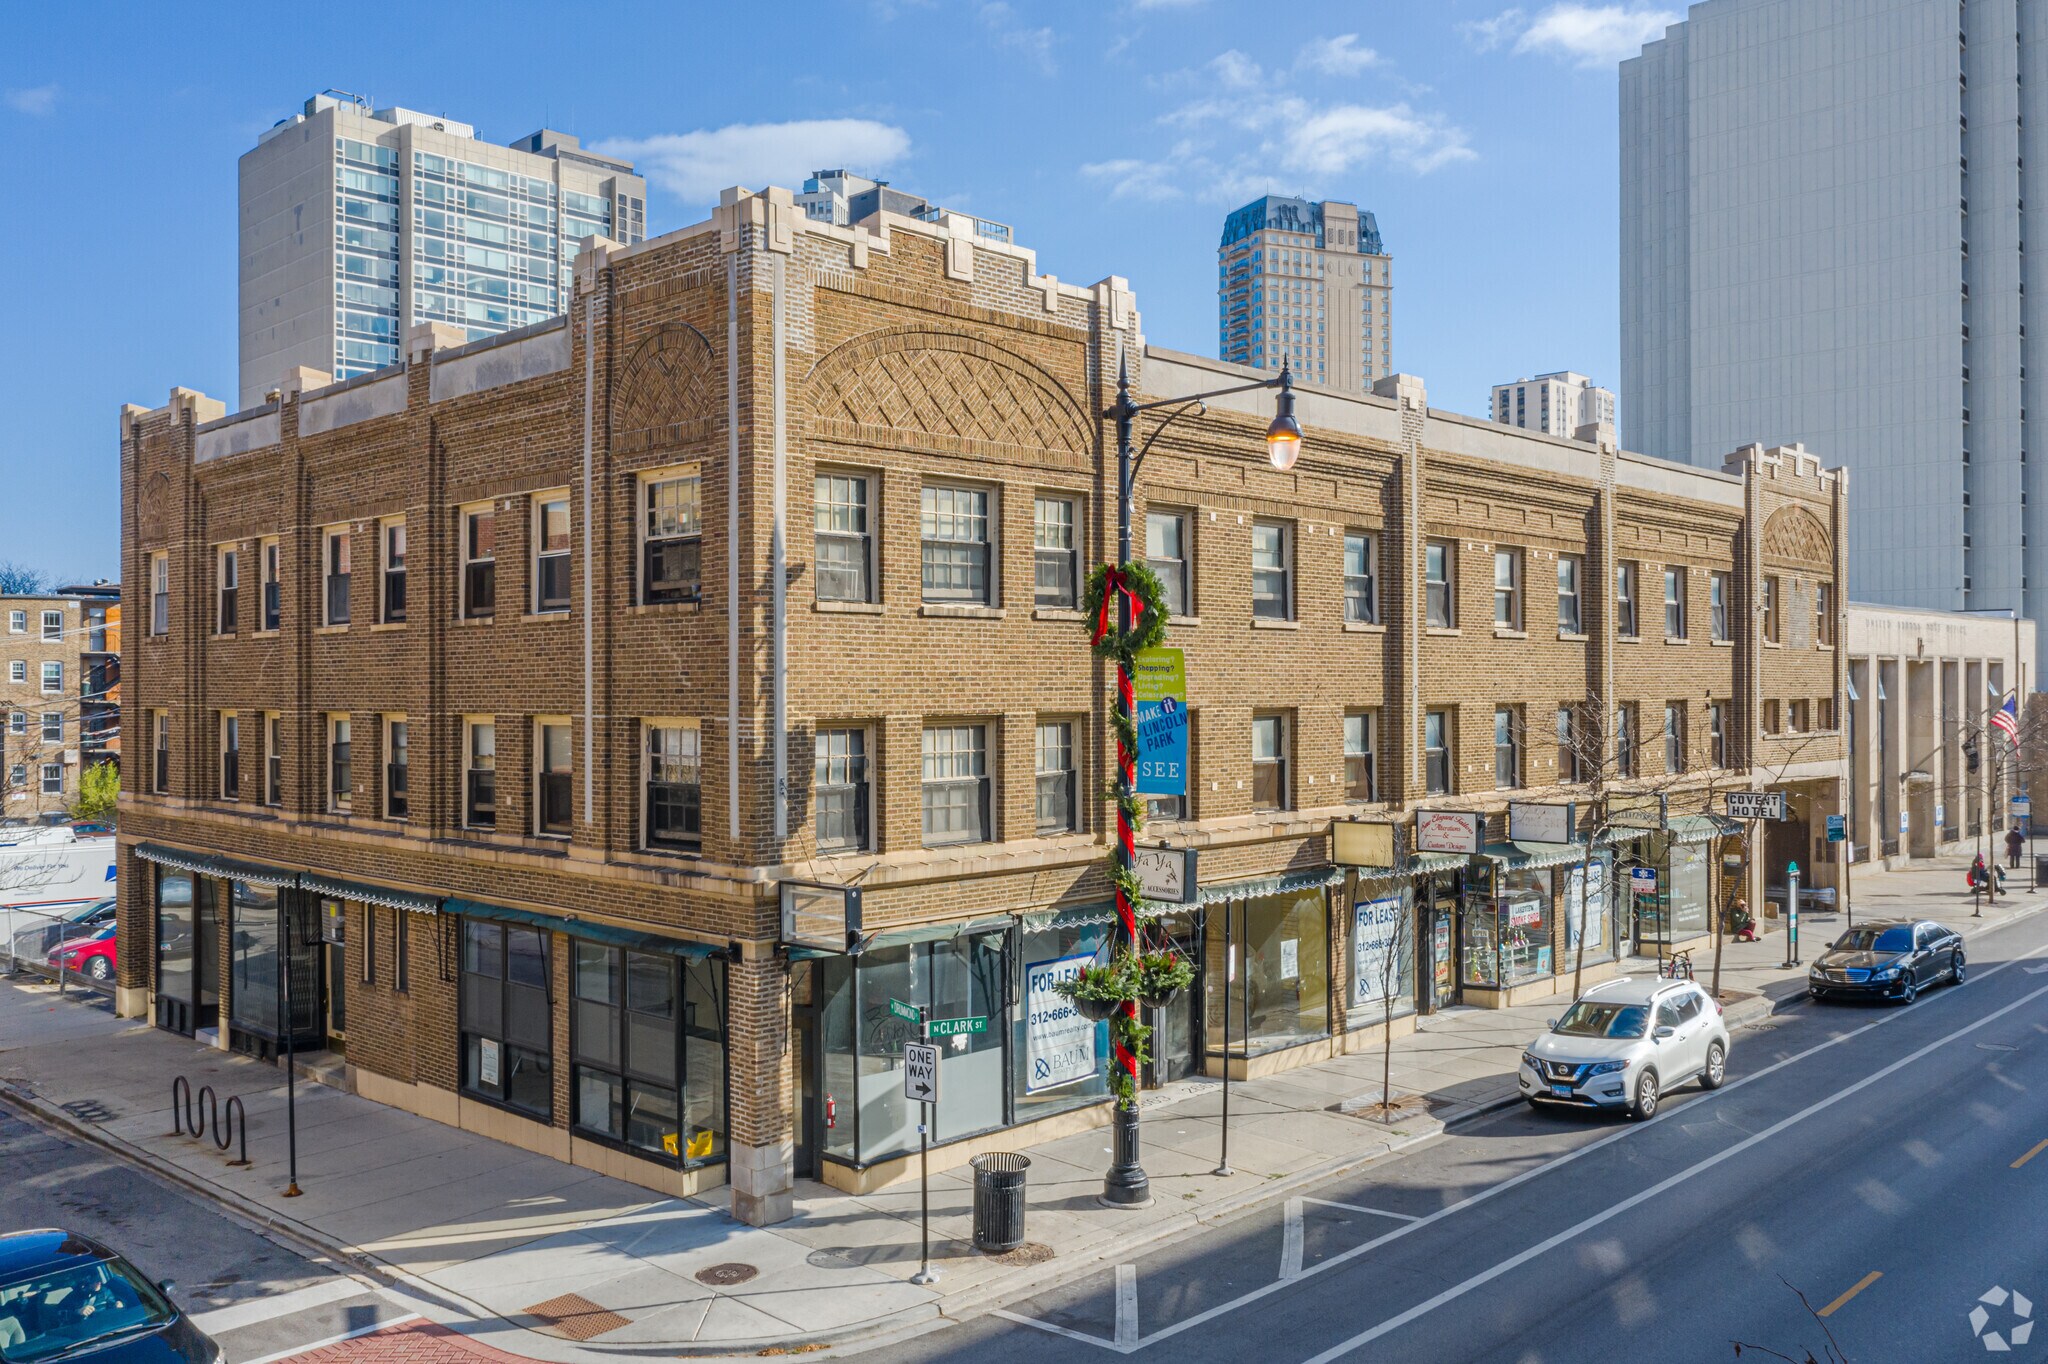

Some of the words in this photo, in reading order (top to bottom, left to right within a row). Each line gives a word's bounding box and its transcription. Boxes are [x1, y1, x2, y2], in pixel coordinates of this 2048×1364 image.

[1138, 664, 1175, 673] Shopping?
[1137, 705, 1162, 724] MAKE
[1163, 698, 1175, 714] it
[1143, 711, 1188, 738] LINCOLN
[1146, 731, 1175, 752] PARK
[1142, 761, 1179, 778] SEE
[1730, 795, 1778, 806] COVENT
[1732, 806, 1776, 817] HOTEL
[1153, 853, 1172, 871] Ya
[1358, 911, 1373, 927] FOR
[1375, 907, 1400, 925] LEASE
[1031, 972, 1054, 993] FOR
[894, 1001, 915, 1020] DRUMMOND
[940, 1020, 974, 1034] CLARK
[975, 1021, 982, 1029] ST
[908, 1049, 933, 1065] ONE
[1053, 1047, 1089, 1069] BAUM
[908, 1063, 933, 1080] WAY
